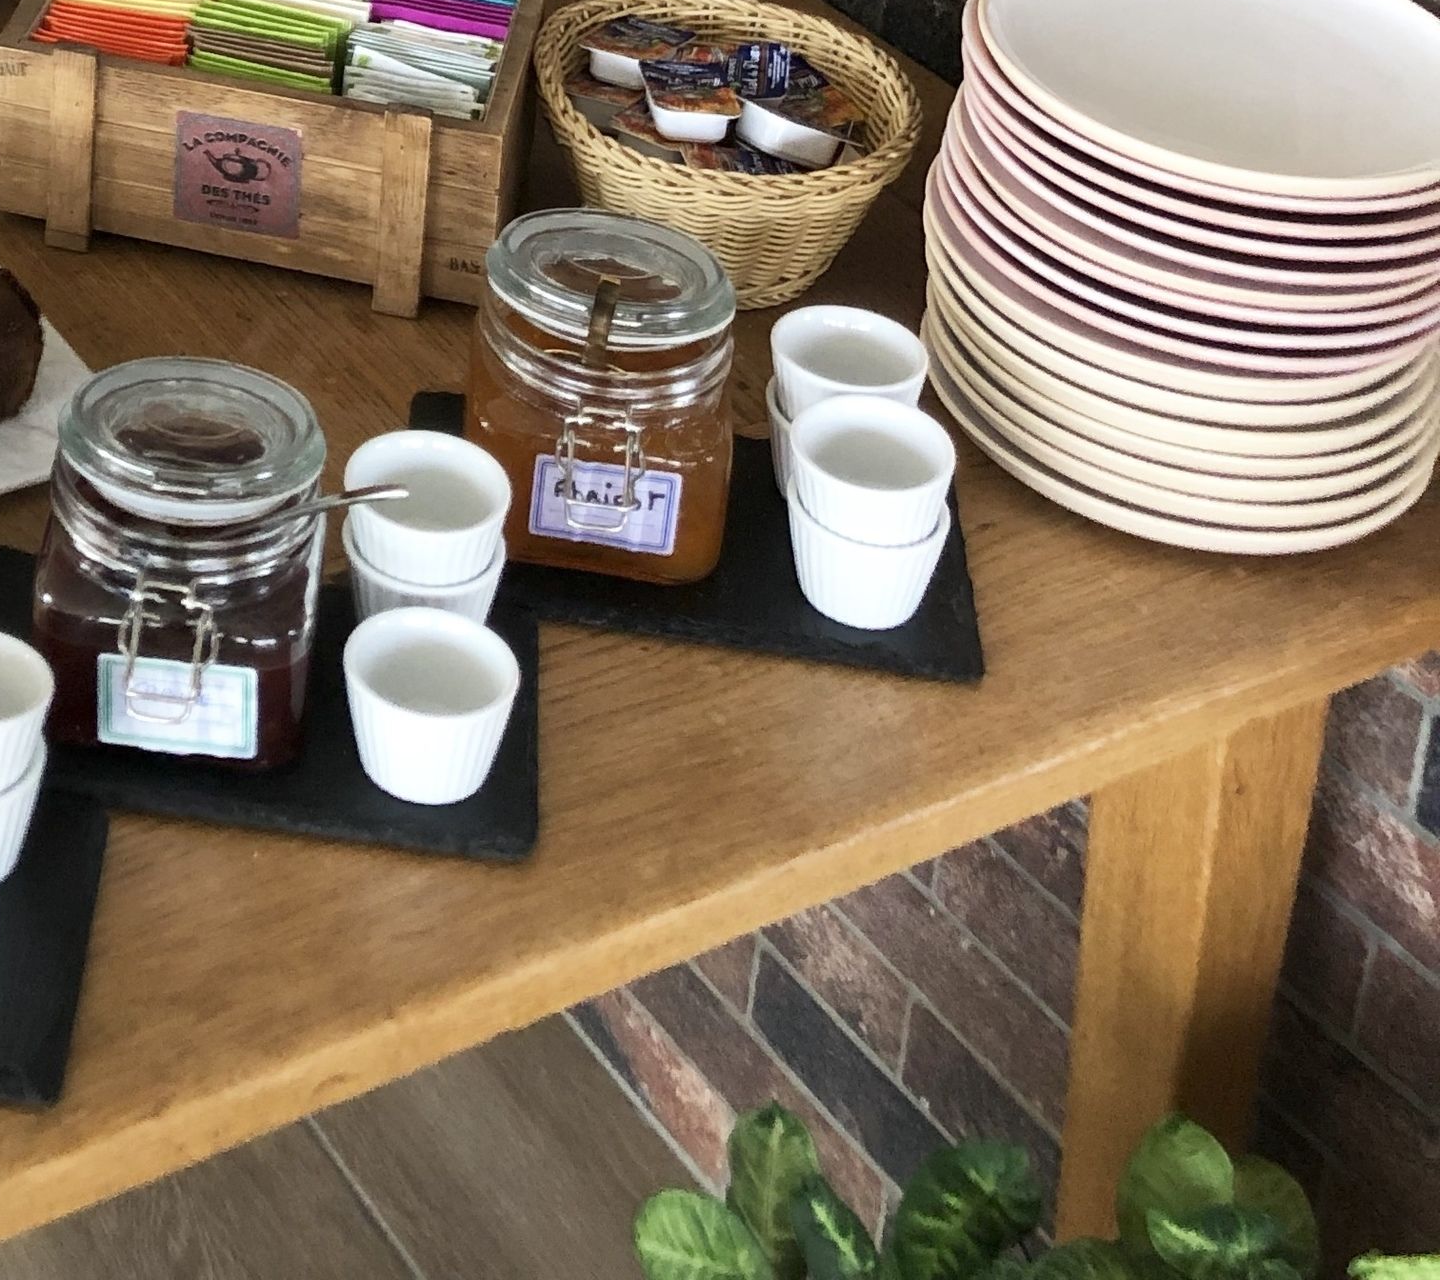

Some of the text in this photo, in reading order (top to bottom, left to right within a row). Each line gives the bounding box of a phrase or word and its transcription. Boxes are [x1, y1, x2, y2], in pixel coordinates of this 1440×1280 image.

[182, 131, 292, 168] LA COMPAGNIE
[201, 184, 271, 206] DES THÉS
